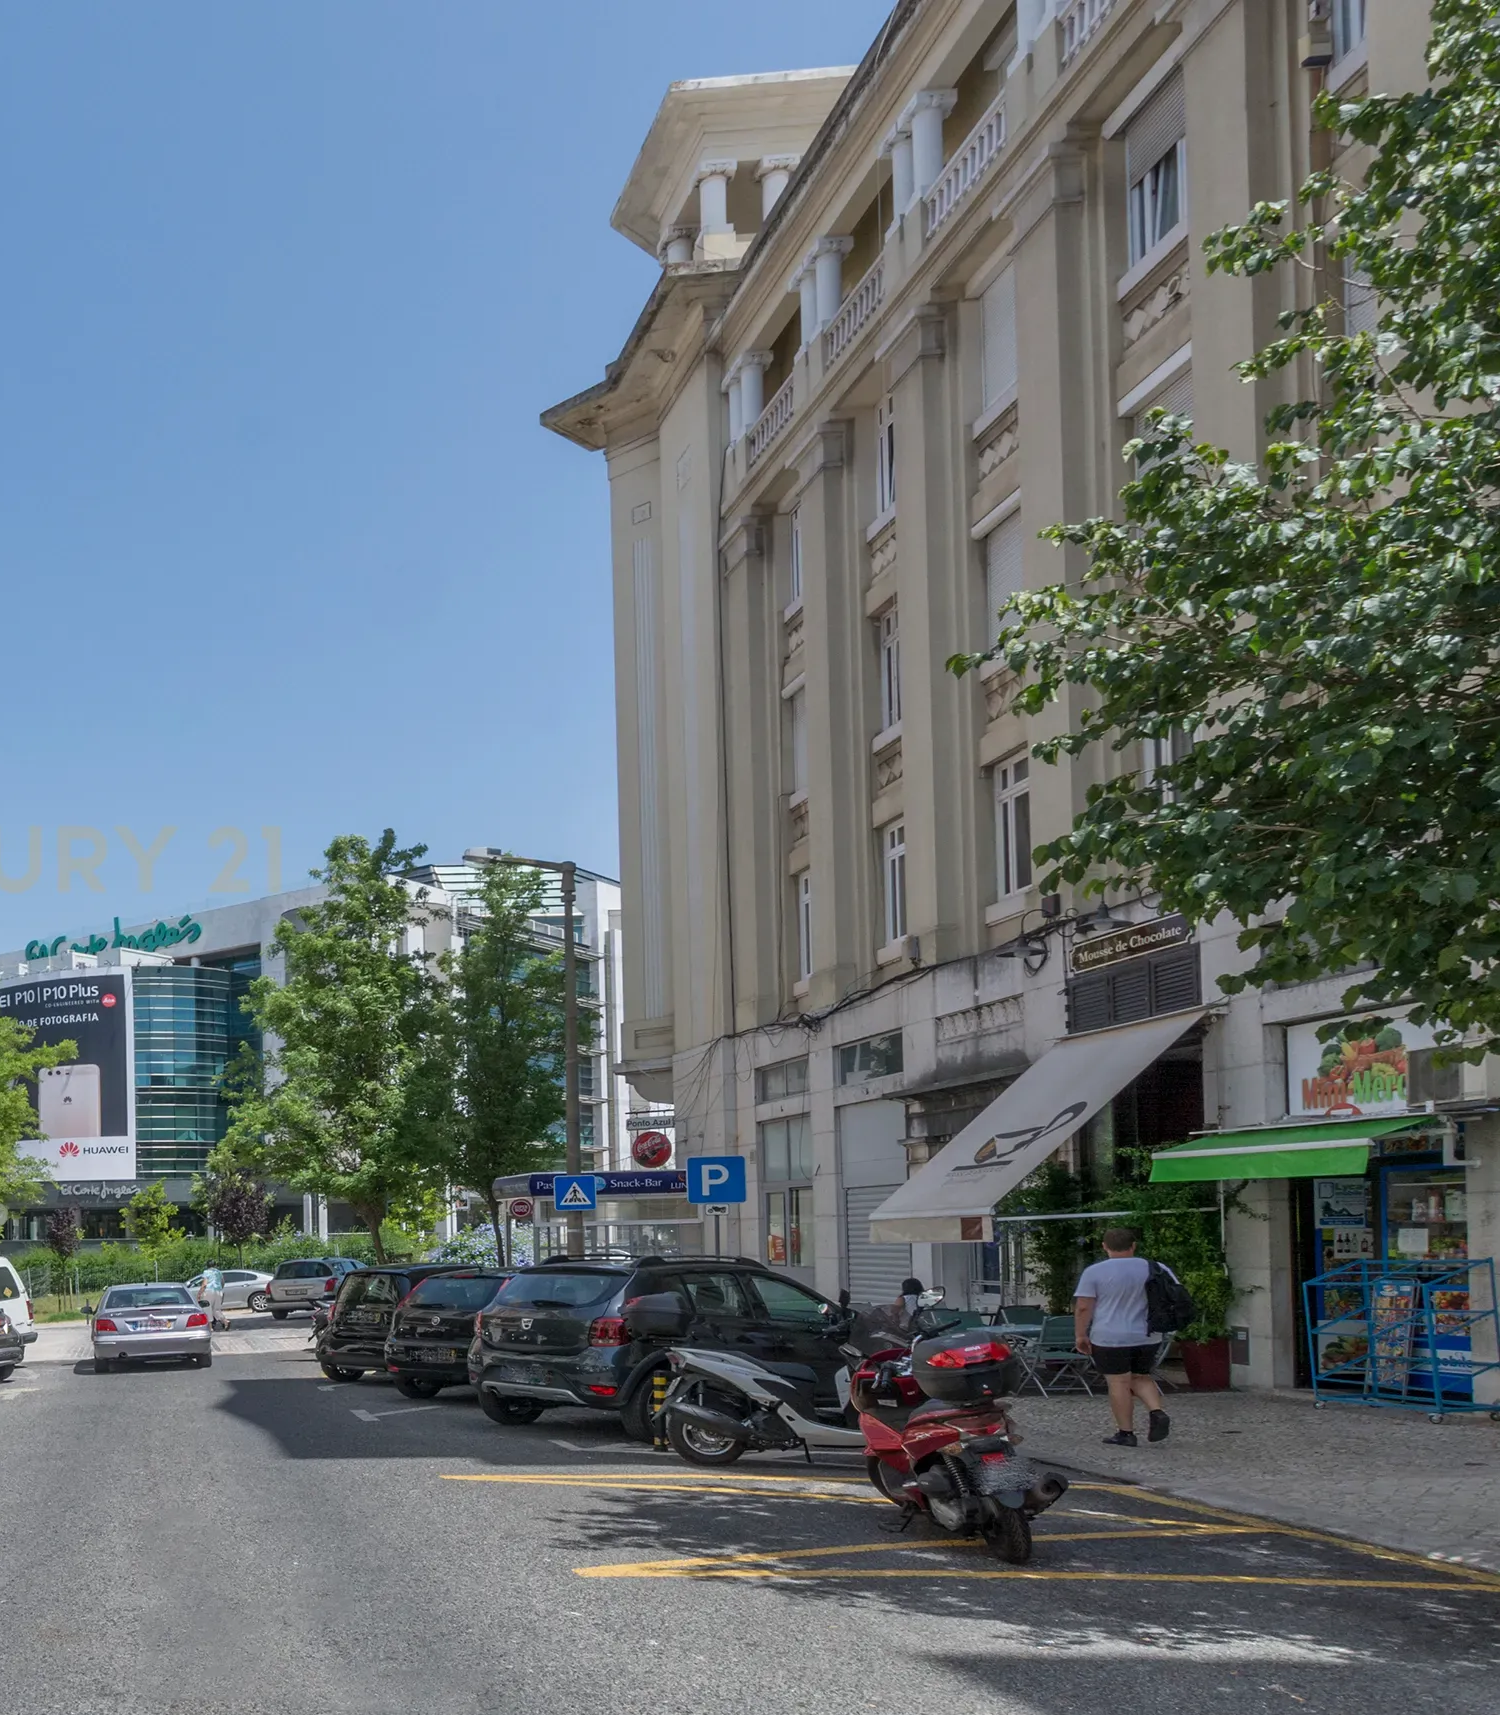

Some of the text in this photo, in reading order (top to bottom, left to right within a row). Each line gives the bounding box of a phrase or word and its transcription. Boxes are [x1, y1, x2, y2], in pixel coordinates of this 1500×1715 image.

[111, 914, 203, 953] Inglés
[1078, 925, 1182, 964] Mousse de Chocolate
[15, 989, 35, 1006] P10
[43, 985, 67, 1002] P10
[69, 983, 99, 999] Plus
[27, 1018, 38, 1028] DE
[40, 1012, 100, 1026] FOTOGRAFIA
[626, 1118, 671, 1128] Ponto Azul
[83, 1145, 129, 1155] HUAWEI
[62, 1180, 141, 1199] El Corte Inglés
[610, 1178, 662, 1189] Snack-Bar
[701, 1164, 730, 1196] P
